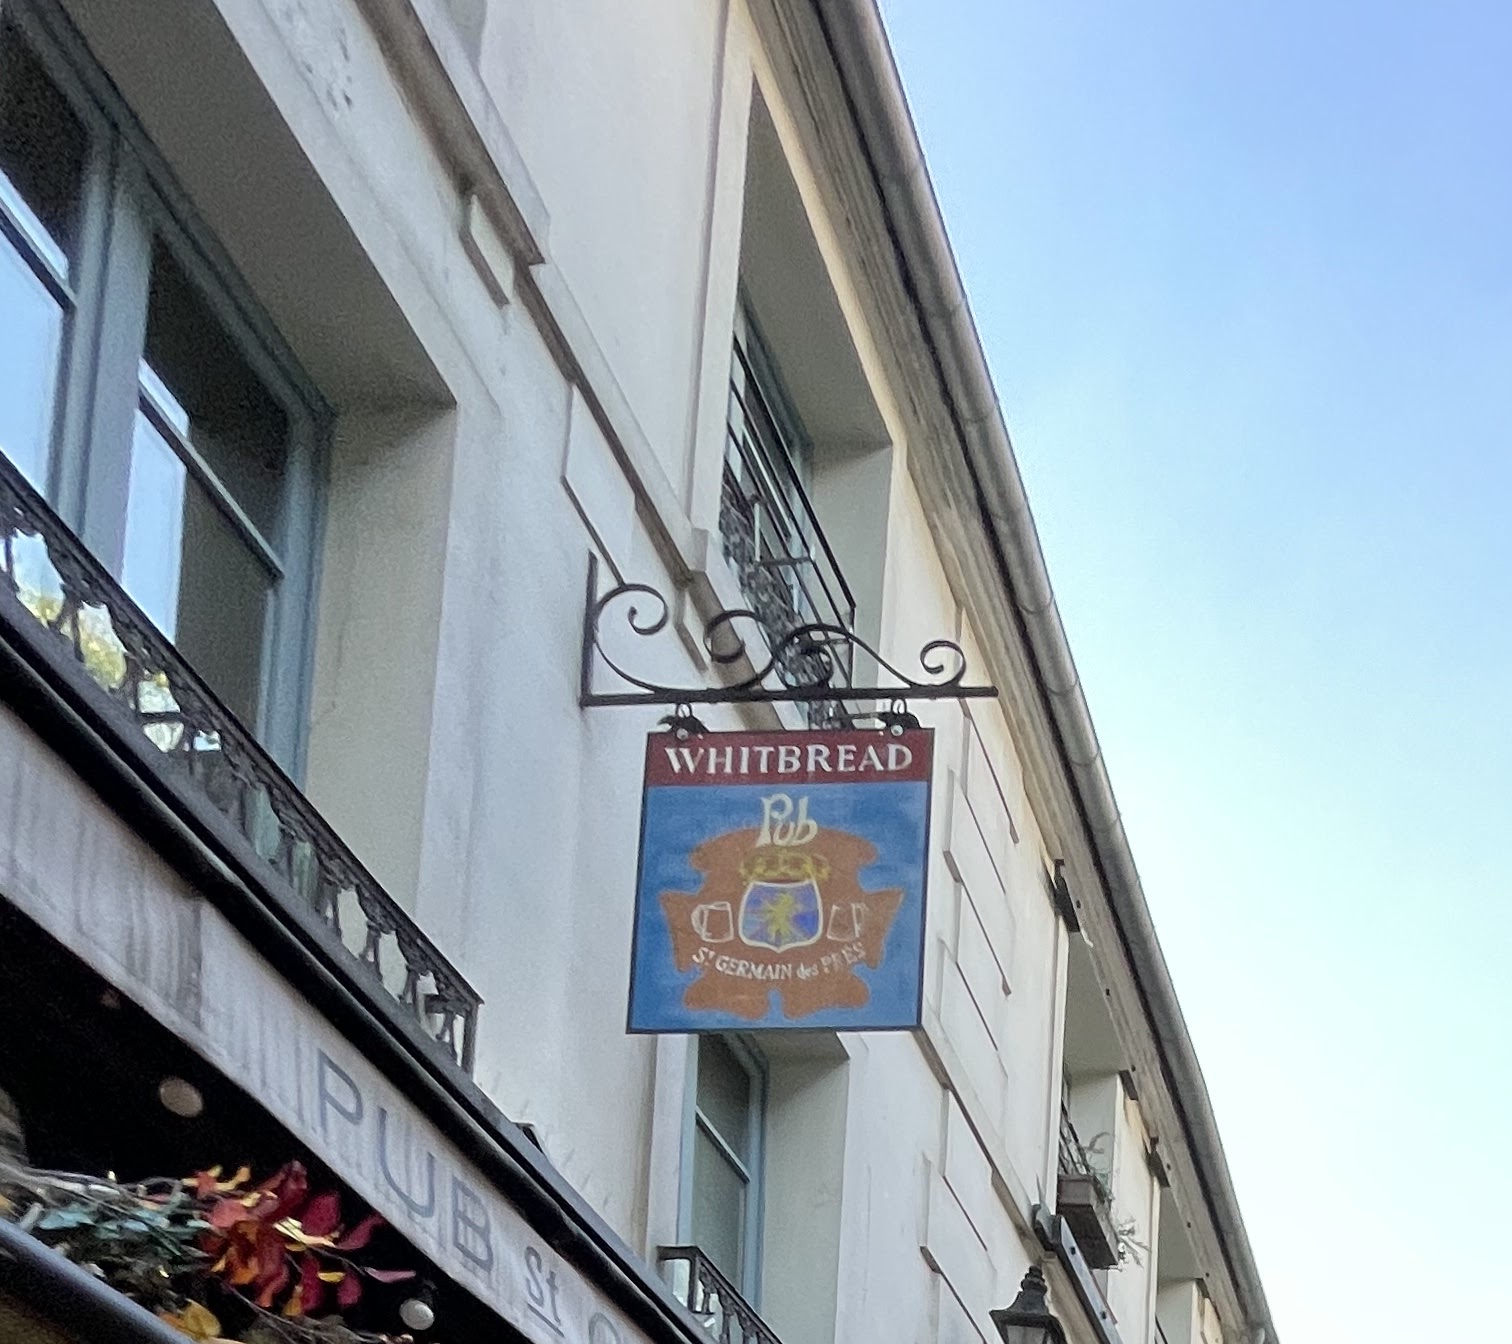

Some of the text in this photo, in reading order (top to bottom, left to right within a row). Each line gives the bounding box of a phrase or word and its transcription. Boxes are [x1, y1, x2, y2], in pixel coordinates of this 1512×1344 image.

[664, 743, 913, 775] WHITBREAD
[756, 793, 818, 848] Pub
[715, 954, 792, 980] GERMAIN
[796, 962, 819, 980] des
[317, 1047, 494, 1274] PUB
[525, 1246, 565, 1334] St
